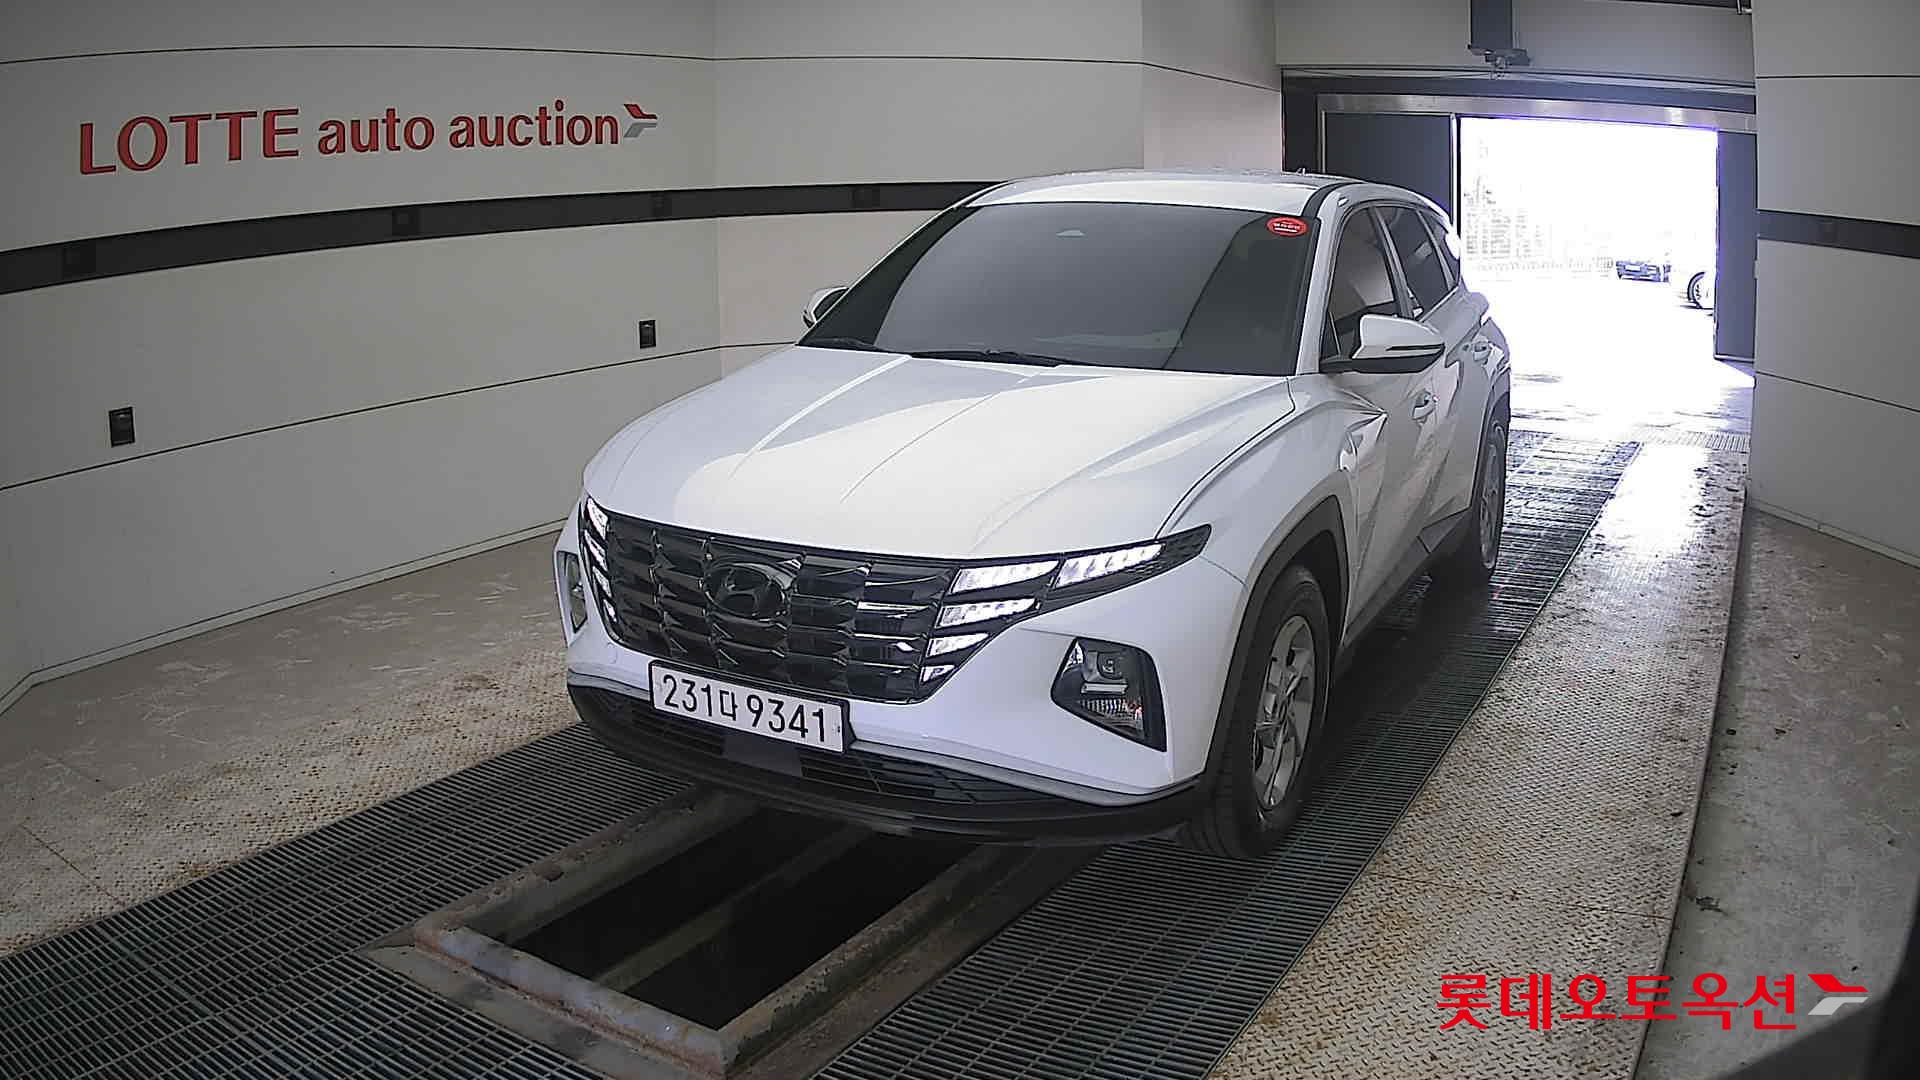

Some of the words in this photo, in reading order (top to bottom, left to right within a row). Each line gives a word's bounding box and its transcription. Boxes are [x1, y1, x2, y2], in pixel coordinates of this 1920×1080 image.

[79, 108, 299, 175] LOTTE
[317, 107, 434, 155] auto
[449, 100, 619, 146] auction
[746, 694, 825, 742] 9341
